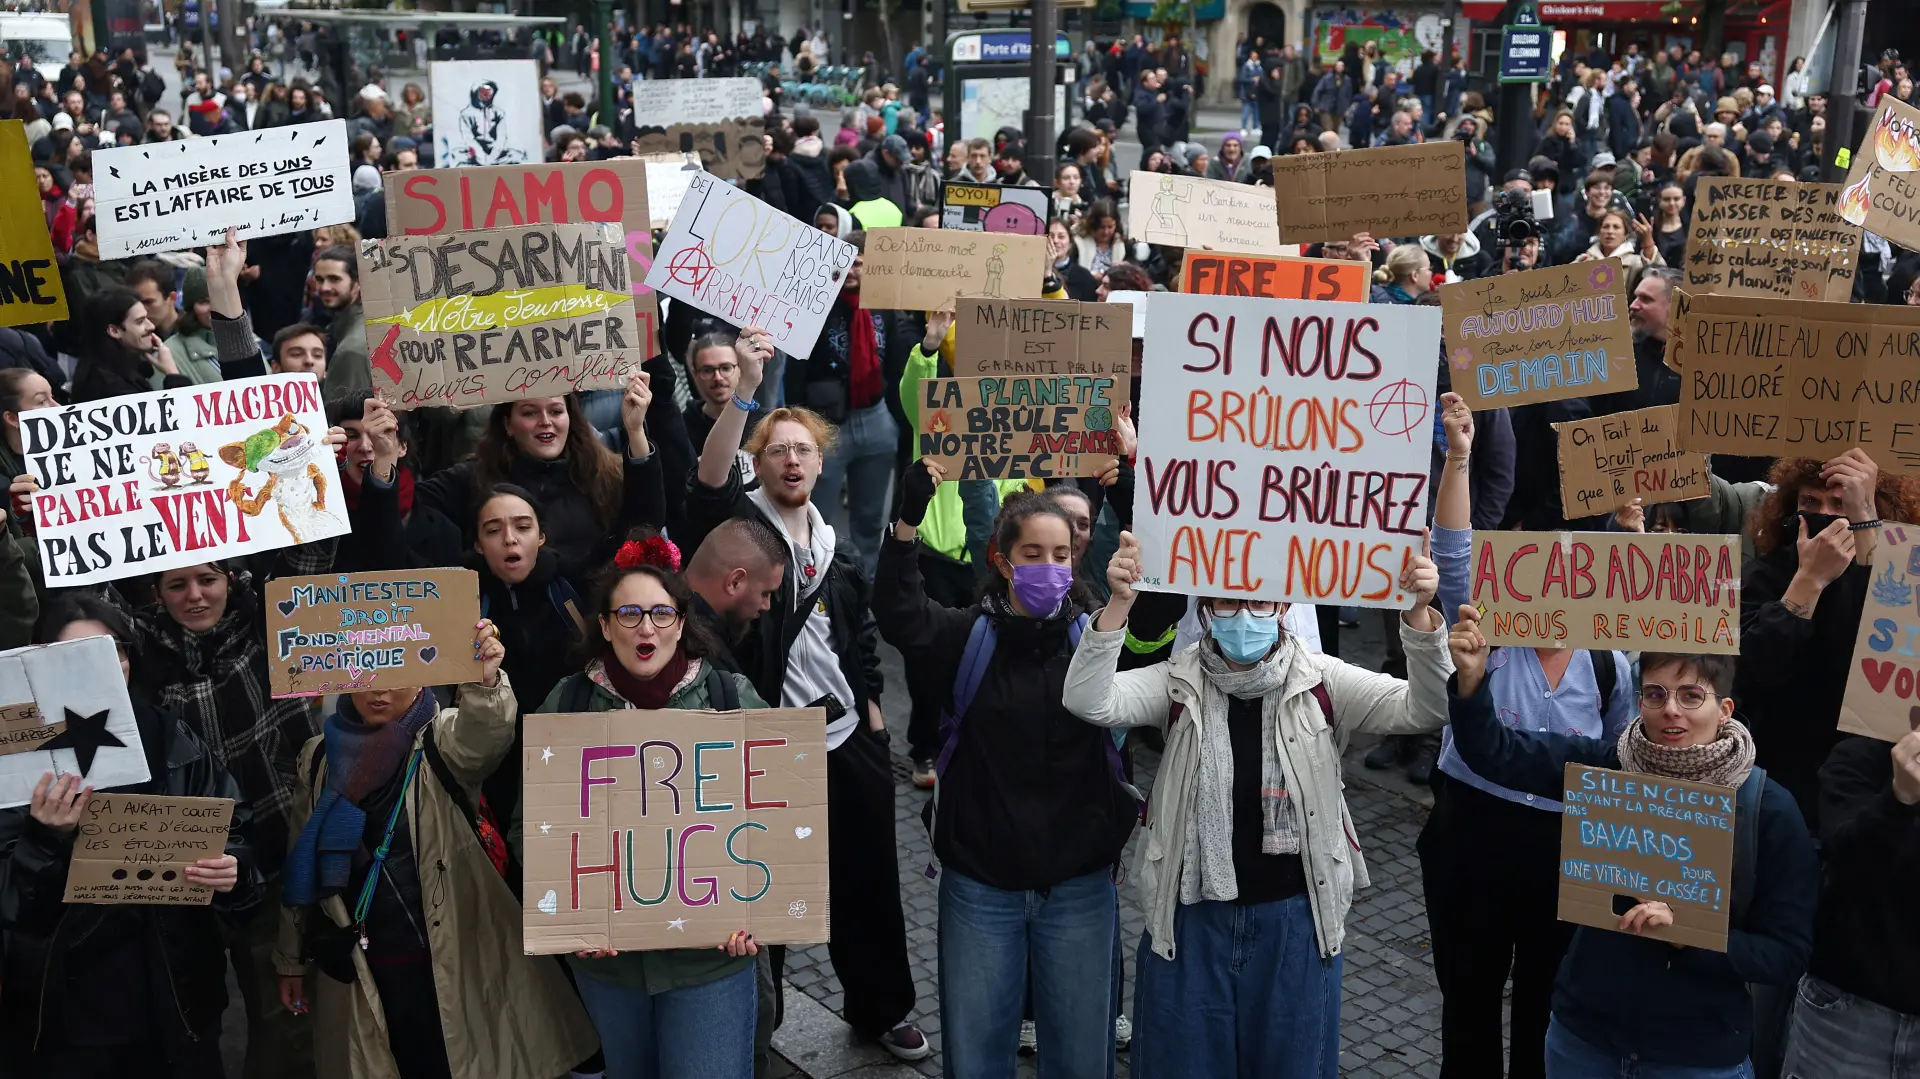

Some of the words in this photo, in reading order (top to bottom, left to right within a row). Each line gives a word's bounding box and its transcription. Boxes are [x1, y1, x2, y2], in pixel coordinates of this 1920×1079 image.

[983, 43, 1008, 55] Porte
[132, 180, 157, 196] LA
[164, 164, 232, 190] MISÈRE
[238, 162, 268, 178] DES
[273, 156, 312, 173] UNS
[690, 174, 710, 194] DE
[1888, 174, 1917, 200] FEU
[114, 201, 151, 222] EST
[156, 184, 254, 216] L'AFFAIRE
[259, 181, 285, 199] DE
[289, 174, 334, 195] TOUS
[404, 168, 624, 236] SIAMO
[946, 186, 990, 200] POYO!
[1258, 202, 1277, 212] veu
[1798, 188, 1821, 204] DE
[279, 214, 304, 229] hugs
[1198, 212, 1218, 223] un
[1332, 221, 1350, 232] du
[1698, 204, 1771, 222] LAISSER
[1780, 206, 1813, 224] DES
[795, 225, 854, 268] DANS
[875, 236, 944, 253] Dessine
[1217, 232, 1260, 247] bureau
[1695, 226, 1718, 240] ON
[1727, 226, 1761, 240] VEUT
[1770, 228, 1792, 242] DES
[410, 230, 628, 302] DÉSARMENT
[784, 249, 831, 288] NOS
[865, 262, 894, 276] une
[1190, 258, 1277, 300] FIRE
[1300, 264, 1342, 301] IS
[1688, 270, 1722, 286] bons
[1728, 250, 1778, 268] calculs
[1800, 258, 1830, 272] sont
[1828, 266, 1853, 284] pas
[1514, 284, 1552, 310] suis
[1555, 275, 1582, 298] là
[415, 294, 497, 334] Notre
[504, 291, 609, 322] Jeunesse
[976, 304, 1110, 334] MANIFESTER
[1460, 294, 1618, 340] AUJOURD'HUI
[398, 338, 447, 364] POUR
[452, 316, 628, 373] RÉARMER
[1024, 342, 1056, 354] EST
[1182, 312, 1236, 376] SI
[1260, 315, 1382, 382] NOUS
[1836, 331, 1869, 358] ON
[978, 360, 1058, 374] GARANTI
[1067, 360, 1087, 374] PAR
[1092, 361, 1104, 373] LA
[1112, 364, 1128, 374] LOI
[1476, 348, 1608, 398] DEMAIN
[926, 381, 963, 408] LA
[978, 376, 1114, 408] PLANÈTE
[1694, 364, 1786, 400] BOLLORÉ
[1802, 376, 1841, 402] ON
[22, 394, 180, 455] DÉSOLÉ
[966, 405, 1078, 434] BRÛLE
[1187, 384, 1364, 453] BRÛLONS
[1572, 427, 1596, 446] On
[1602, 423, 1632, 443] Fait
[1642, 418, 1660, 434] du
[1690, 408, 1780, 440] NUNEZ
[1787, 416, 1873, 444] JUSTE
[920, 432, 1014, 456] NOTRE
[1028, 430, 1120, 456] AVENIR
[1594, 444, 1643, 470] bruit
[33, 452, 76, 490] JE
[92, 442, 136, 480] NE
[36, 480, 144, 528] PARLE
[1144, 456, 1240, 520] VOUS
[1258, 462, 1428, 536] BRÛLEREZ
[1576, 487, 1604, 511] que
[1613, 478, 1626, 496] le
[1633, 468, 1667, 494] RN
[1670, 470, 1698, 490] dort
[43, 532, 113, 577] PAS
[120, 522, 168, 564] LE
[150, 486, 252, 552] VENT
[1168, 524, 1263, 592] AVEC
[1494, 610, 1568, 640] NOUS
[1861, 658, 1920, 701] VO
[580, 738, 788, 818] FREE
[88, 800, 112, 820] ÇA
[1566, 790, 1622, 808] DEVANT
[1626, 800, 1644, 813] LA
[108, 822, 149, 834] CHER
[158, 820, 230, 834] D'ÉCOUTER
[1580, 820, 1694, 861] BAVARDS
[85, 840, 110, 851] LES
[570, 822, 772, 913] HUGS
[1562, 860, 1592, 880] UNE
[1682, 866, 1716, 882] POUR
